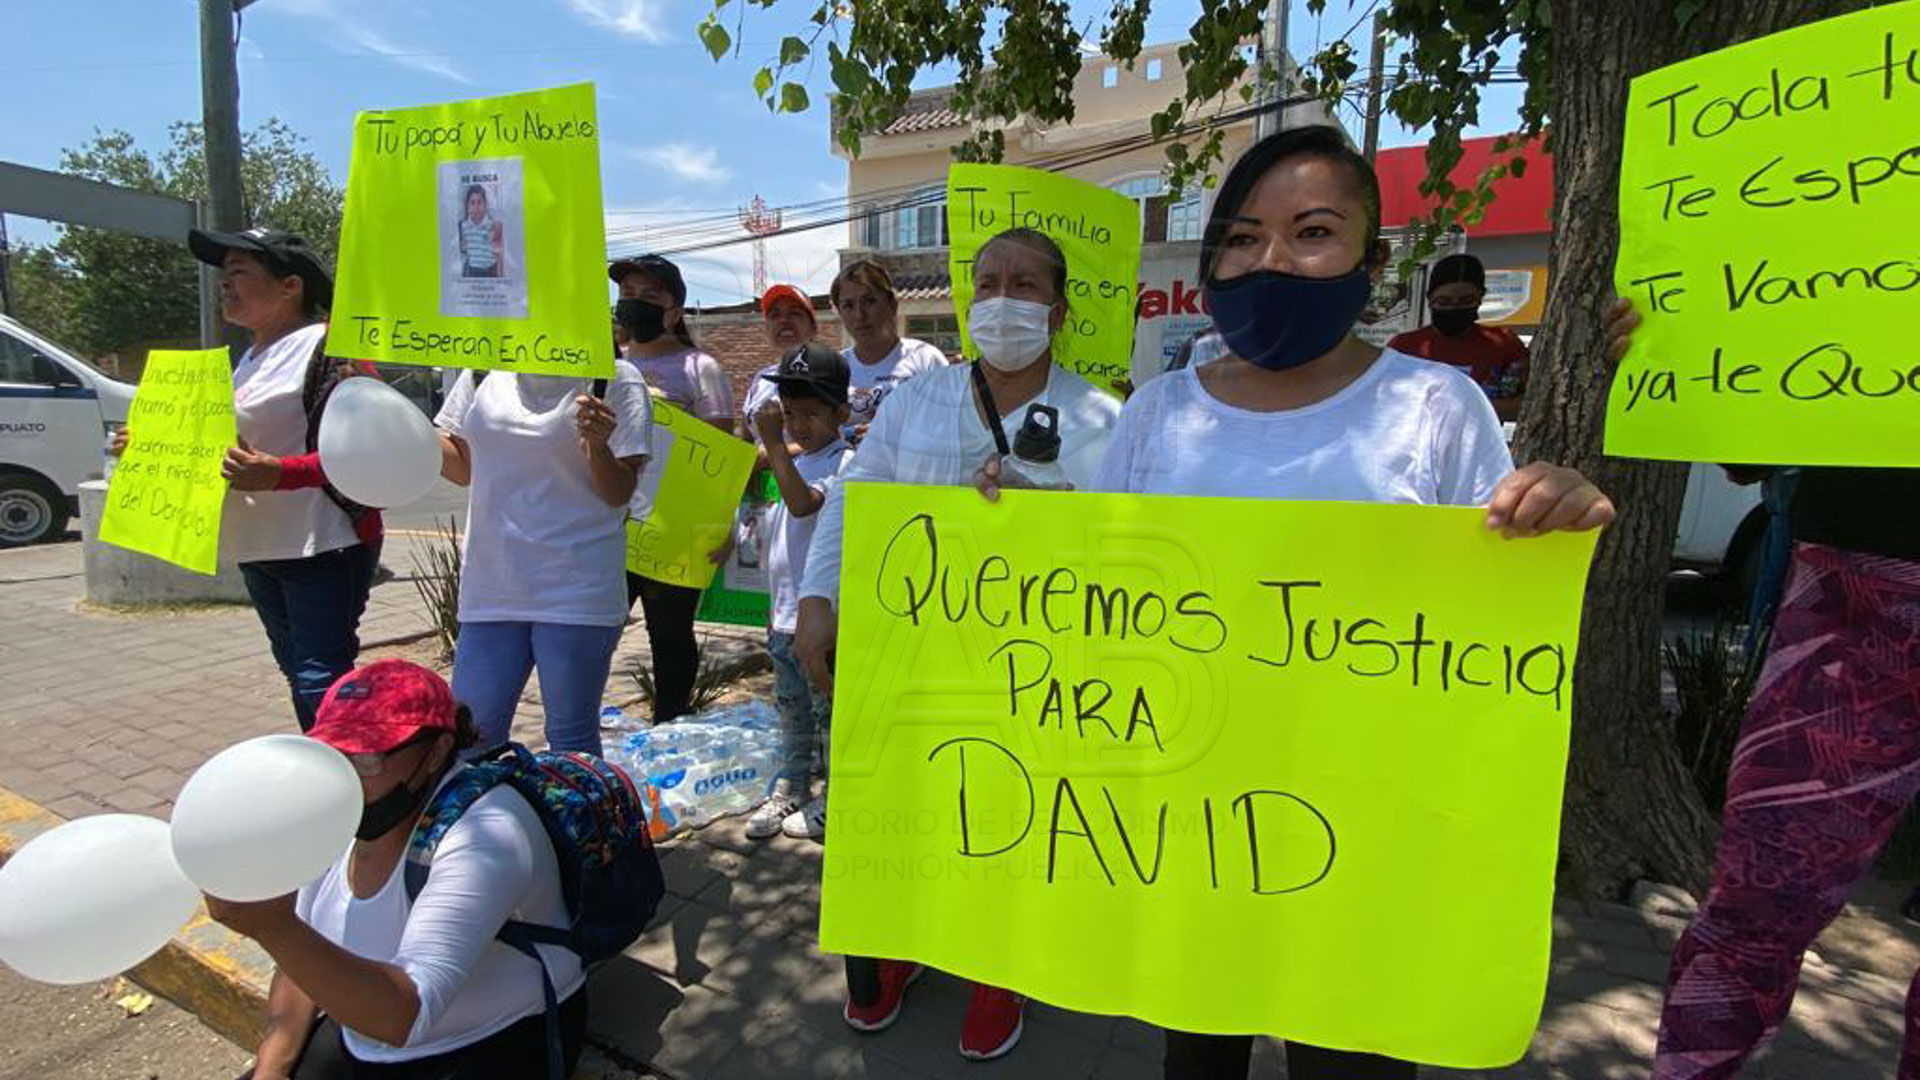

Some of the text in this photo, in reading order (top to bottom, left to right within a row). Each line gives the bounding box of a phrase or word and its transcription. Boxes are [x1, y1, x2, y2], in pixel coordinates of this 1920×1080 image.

[366, 118, 399, 154] Tu
[474, 125, 487, 156] y
[490, 113, 519, 143] Tu
[522, 108, 596, 141] Abuelo
[954, 186, 995, 233] Tu
[1643, 175, 1717, 221] Te
[1099, 280, 1131, 308] en
[1630, 258, 1920, 313] Te Vamo
[351, 316, 591, 365] Te Esperan En Casa
[1689, 347, 1763, 393] te
[682, 435, 728, 478] TU
[876, 513, 1566, 711] Queremos Justicia
[987, 638, 1165, 752] PARA
[928, 736, 1337, 895] DAVID
